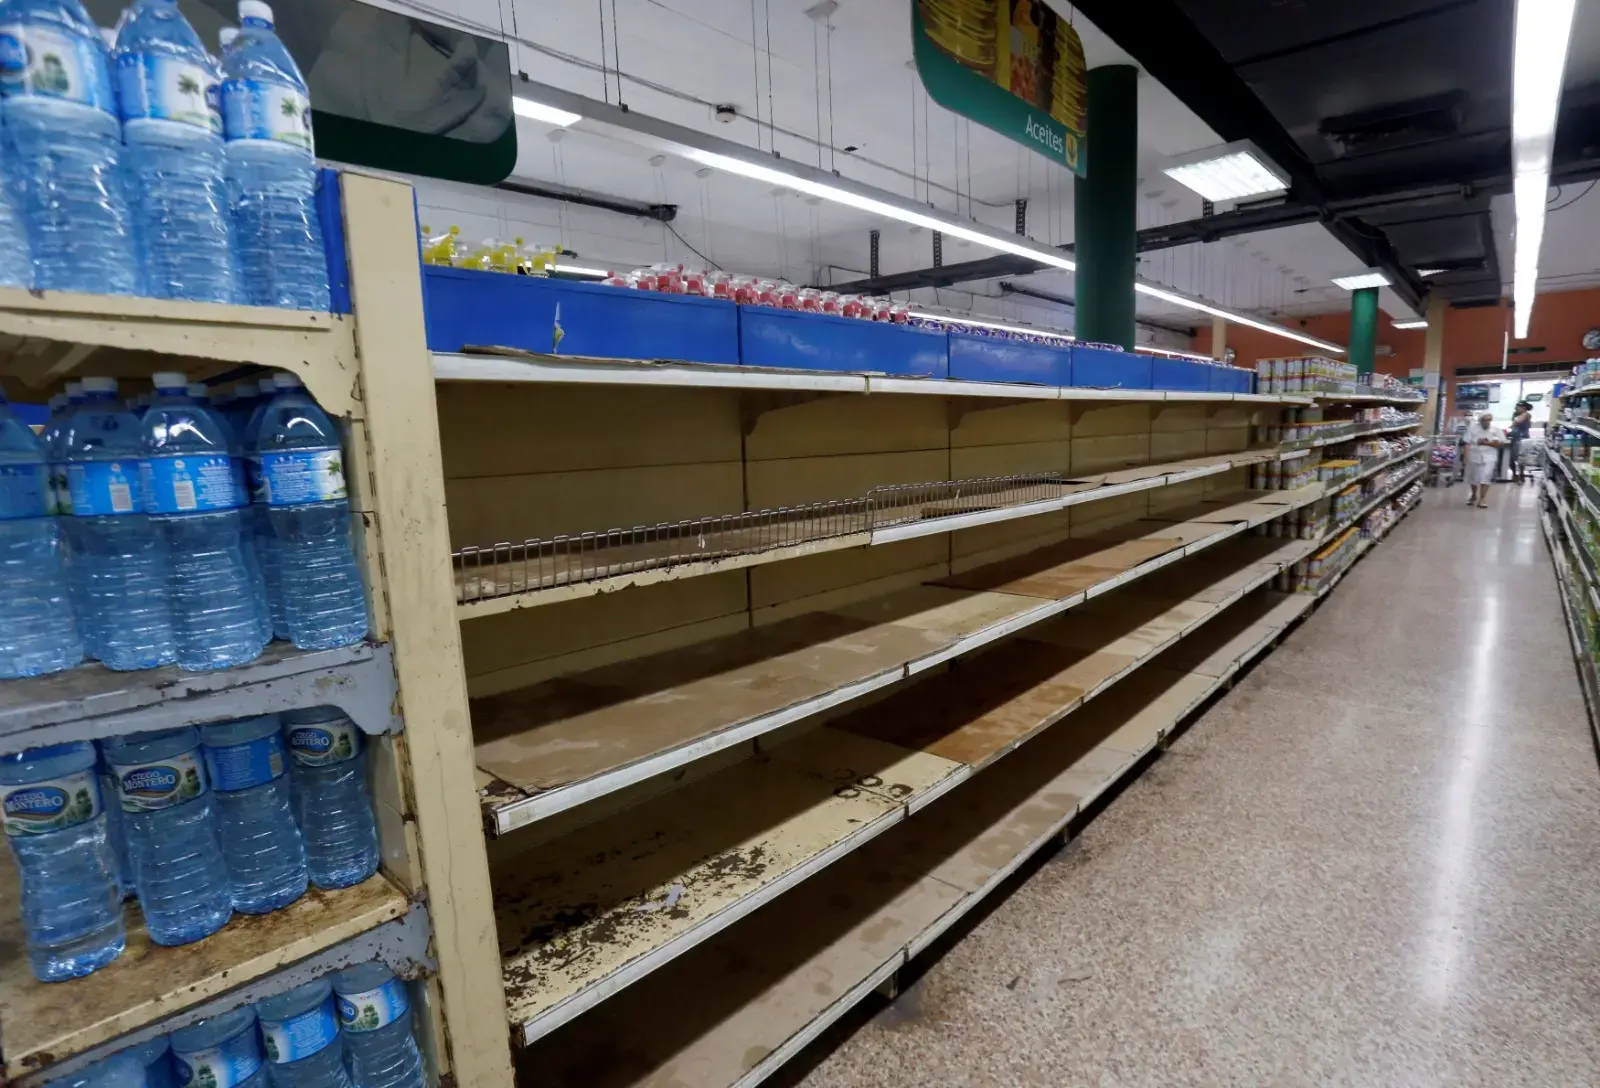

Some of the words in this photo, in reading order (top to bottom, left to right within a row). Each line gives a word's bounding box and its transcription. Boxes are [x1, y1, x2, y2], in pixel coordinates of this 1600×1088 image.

[1025, 114, 1064, 153] Aceites
[123, 774, 175, 791] MONTERO
[131, 770, 160, 781] CIEGO
[5, 795, 64, 813] MONTERO
[12, 791, 46, 802] CIEGO
